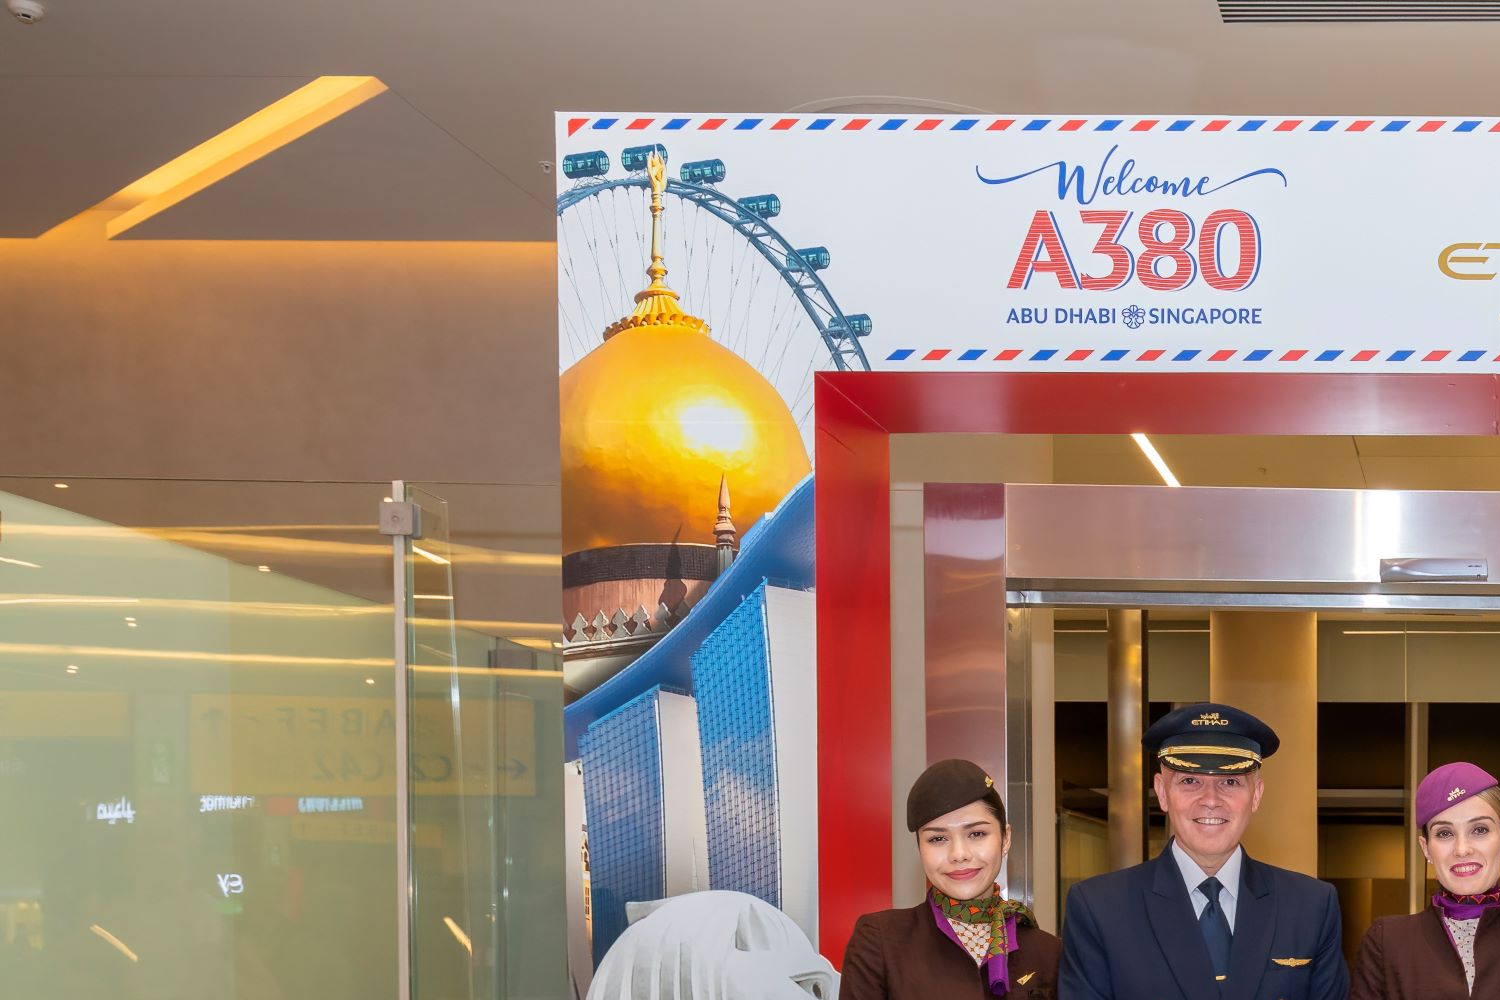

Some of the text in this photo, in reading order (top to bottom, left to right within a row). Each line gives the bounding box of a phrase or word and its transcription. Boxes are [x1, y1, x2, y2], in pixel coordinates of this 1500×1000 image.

[976, 144, 1288, 205] Welcome
[1006, 208, 1262, 293] A380
[1005, 307, 1263, 325] ABU DHABI SINGAPORE
